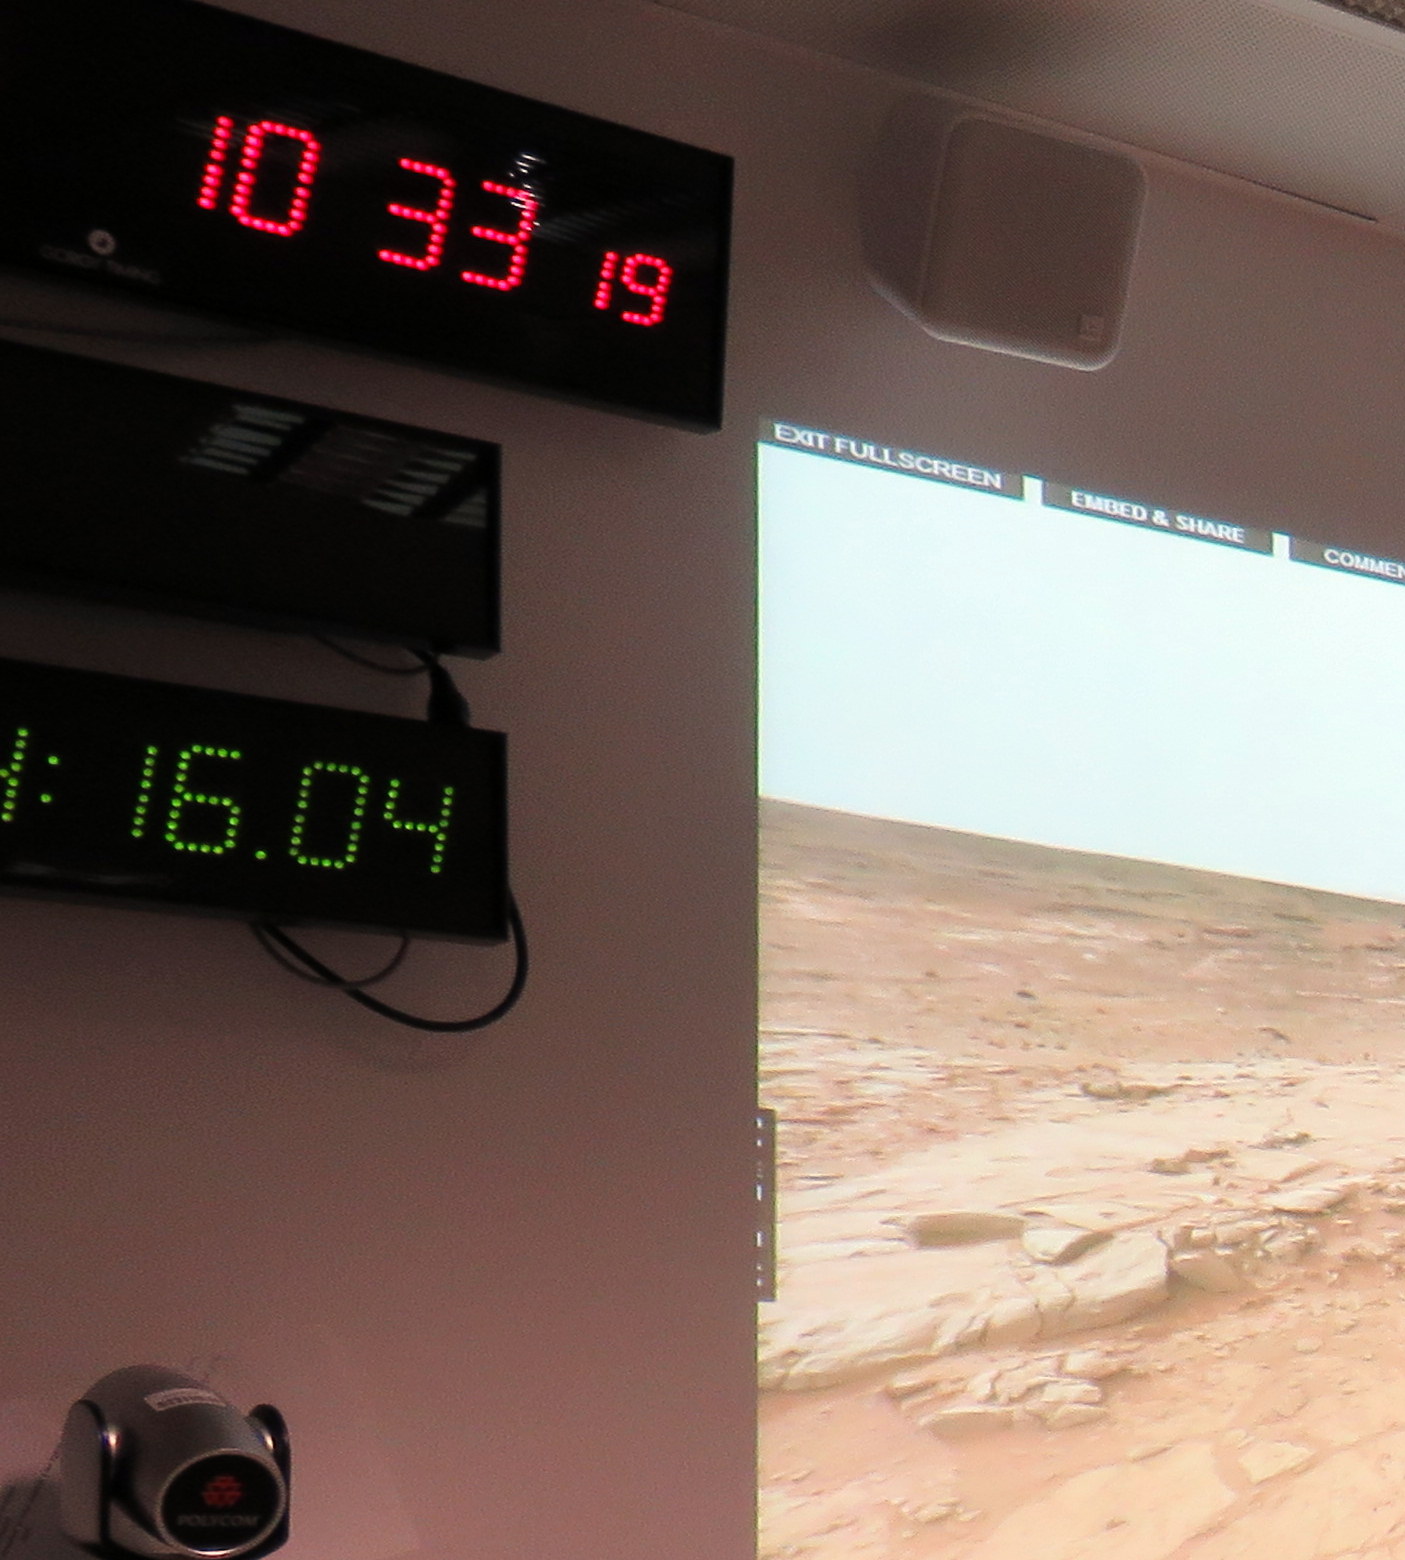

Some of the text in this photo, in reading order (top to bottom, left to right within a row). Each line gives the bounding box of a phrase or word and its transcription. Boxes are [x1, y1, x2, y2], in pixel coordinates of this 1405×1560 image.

[197, 114, 674, 328] 10 33 19
[774, 422, 1001, 490] EXIT FULLSCREEN
[1071, 490, 1245, 544] EMBED & SHARE
[130, 744, 455, 875] 16.04
[177, 1514, 258, 1528] POLYCOM
